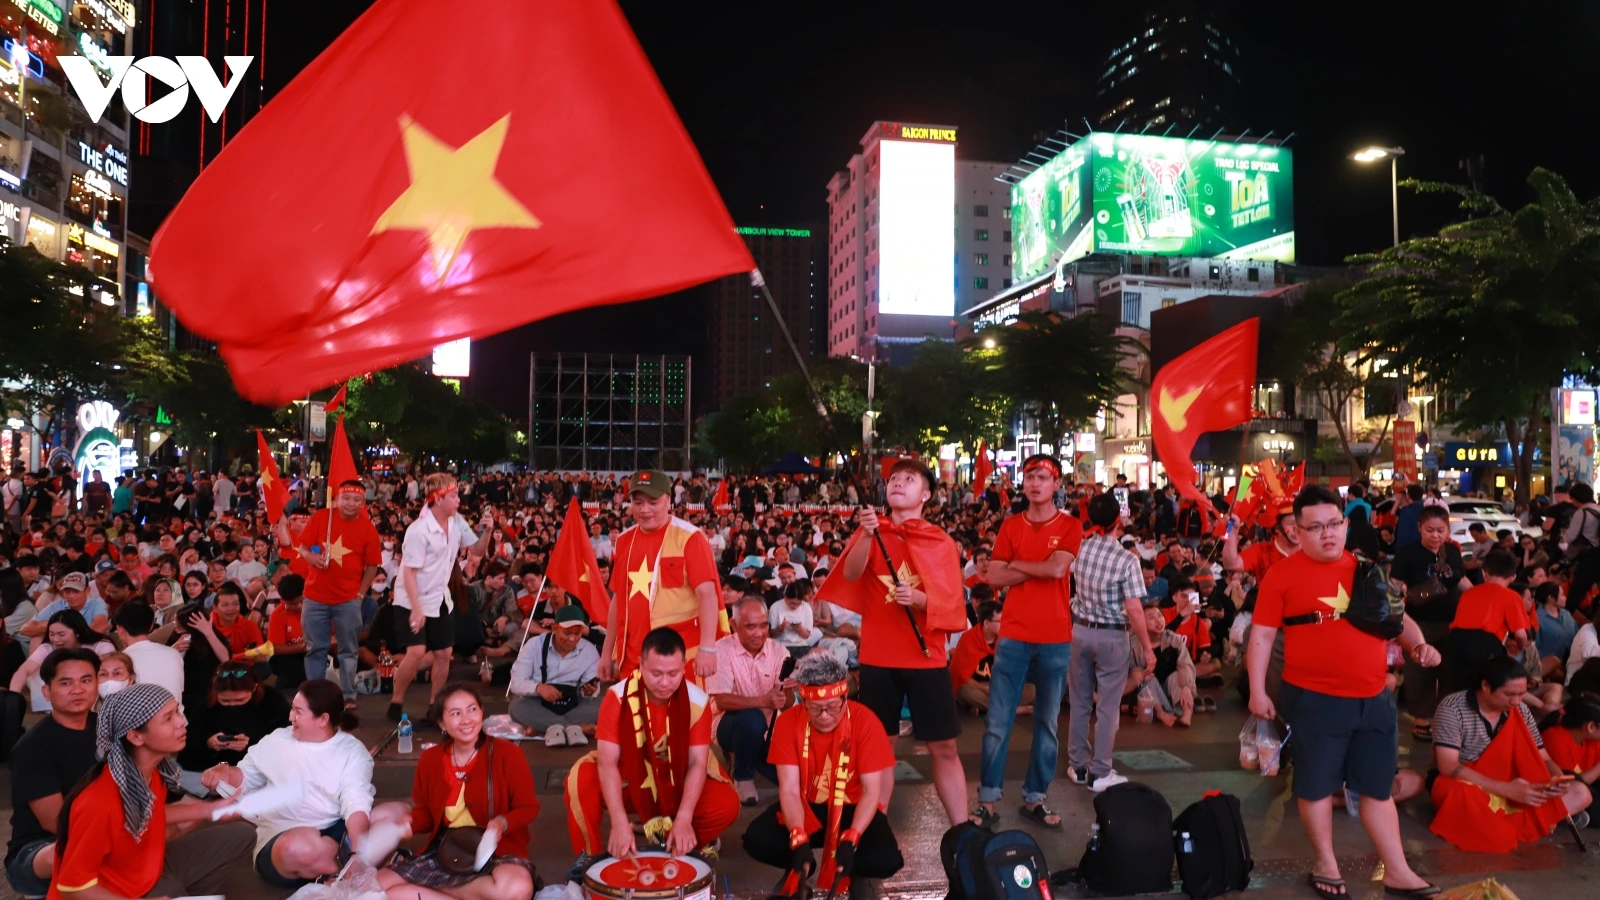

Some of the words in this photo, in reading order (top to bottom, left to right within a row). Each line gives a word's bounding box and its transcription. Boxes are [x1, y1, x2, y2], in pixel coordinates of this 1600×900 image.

[27, 5, 59, 36] LETTER
[902, 126, 929, 139] SAIGON
[930, 128, 957, 142] PRINCE
[78, 140, 103, 172] THE
[105, 158, 128, 186] ONE
[733, 226, 767, 236] HARBOUR
[767, 227, 785, 237] VIEW
[785, 228, 811, 238] TOWER
